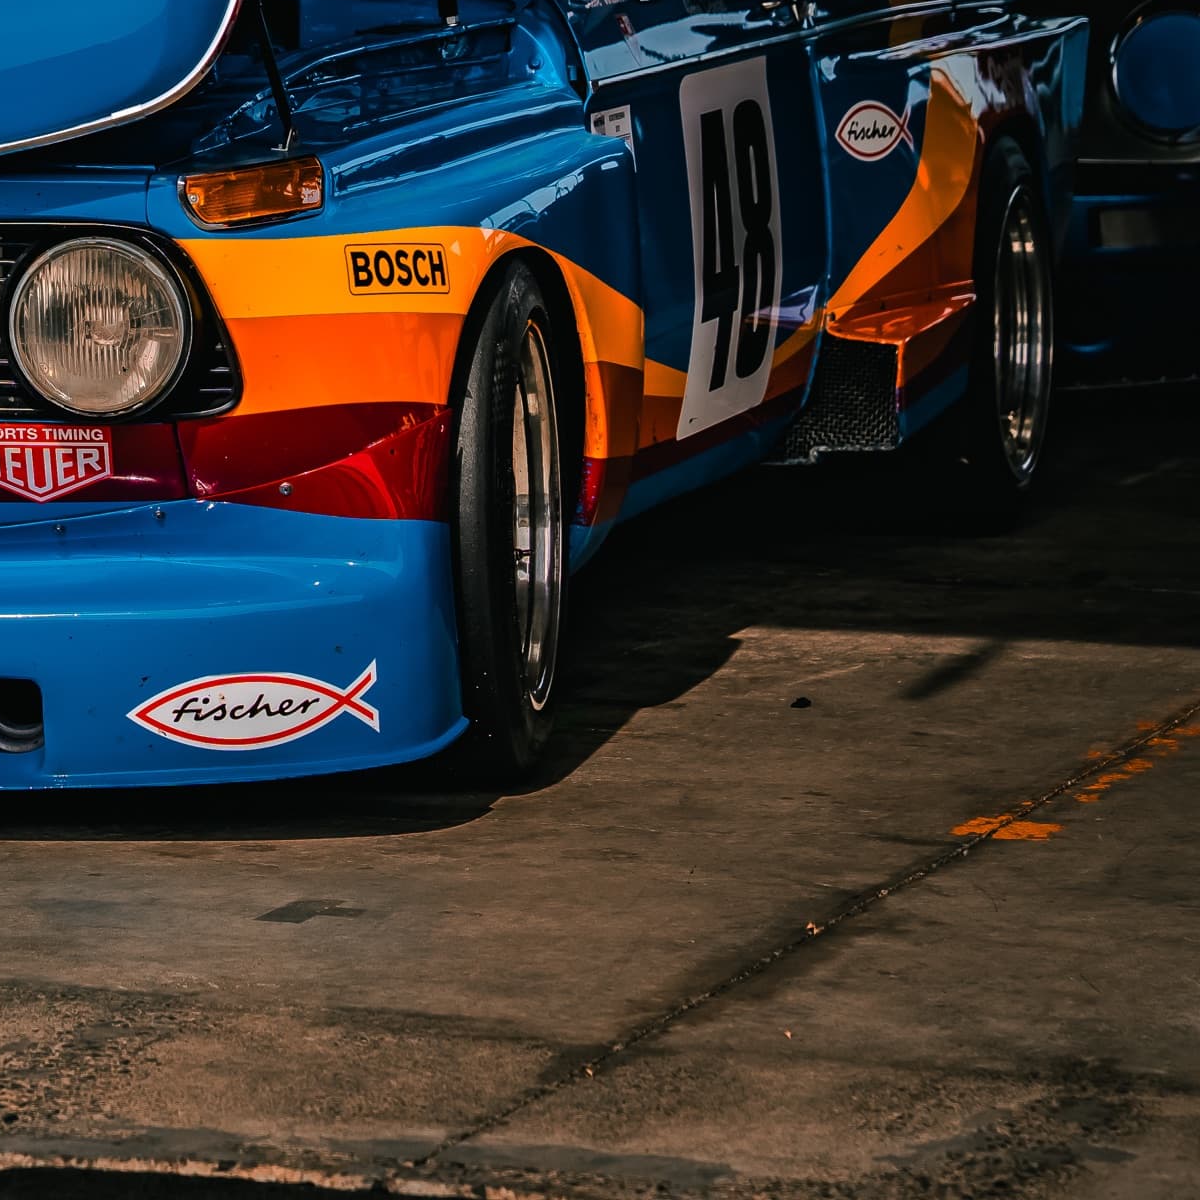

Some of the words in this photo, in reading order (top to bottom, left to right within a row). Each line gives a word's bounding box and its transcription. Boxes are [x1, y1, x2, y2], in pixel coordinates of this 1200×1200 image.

[848, 120, 896, 142] fischer
[700, 99, 776, 392] 48
[350, 250, 446, 287] BOSCH
[42, 427, 104, 442] TIMING
[172, 693, 320, 723] fischer
